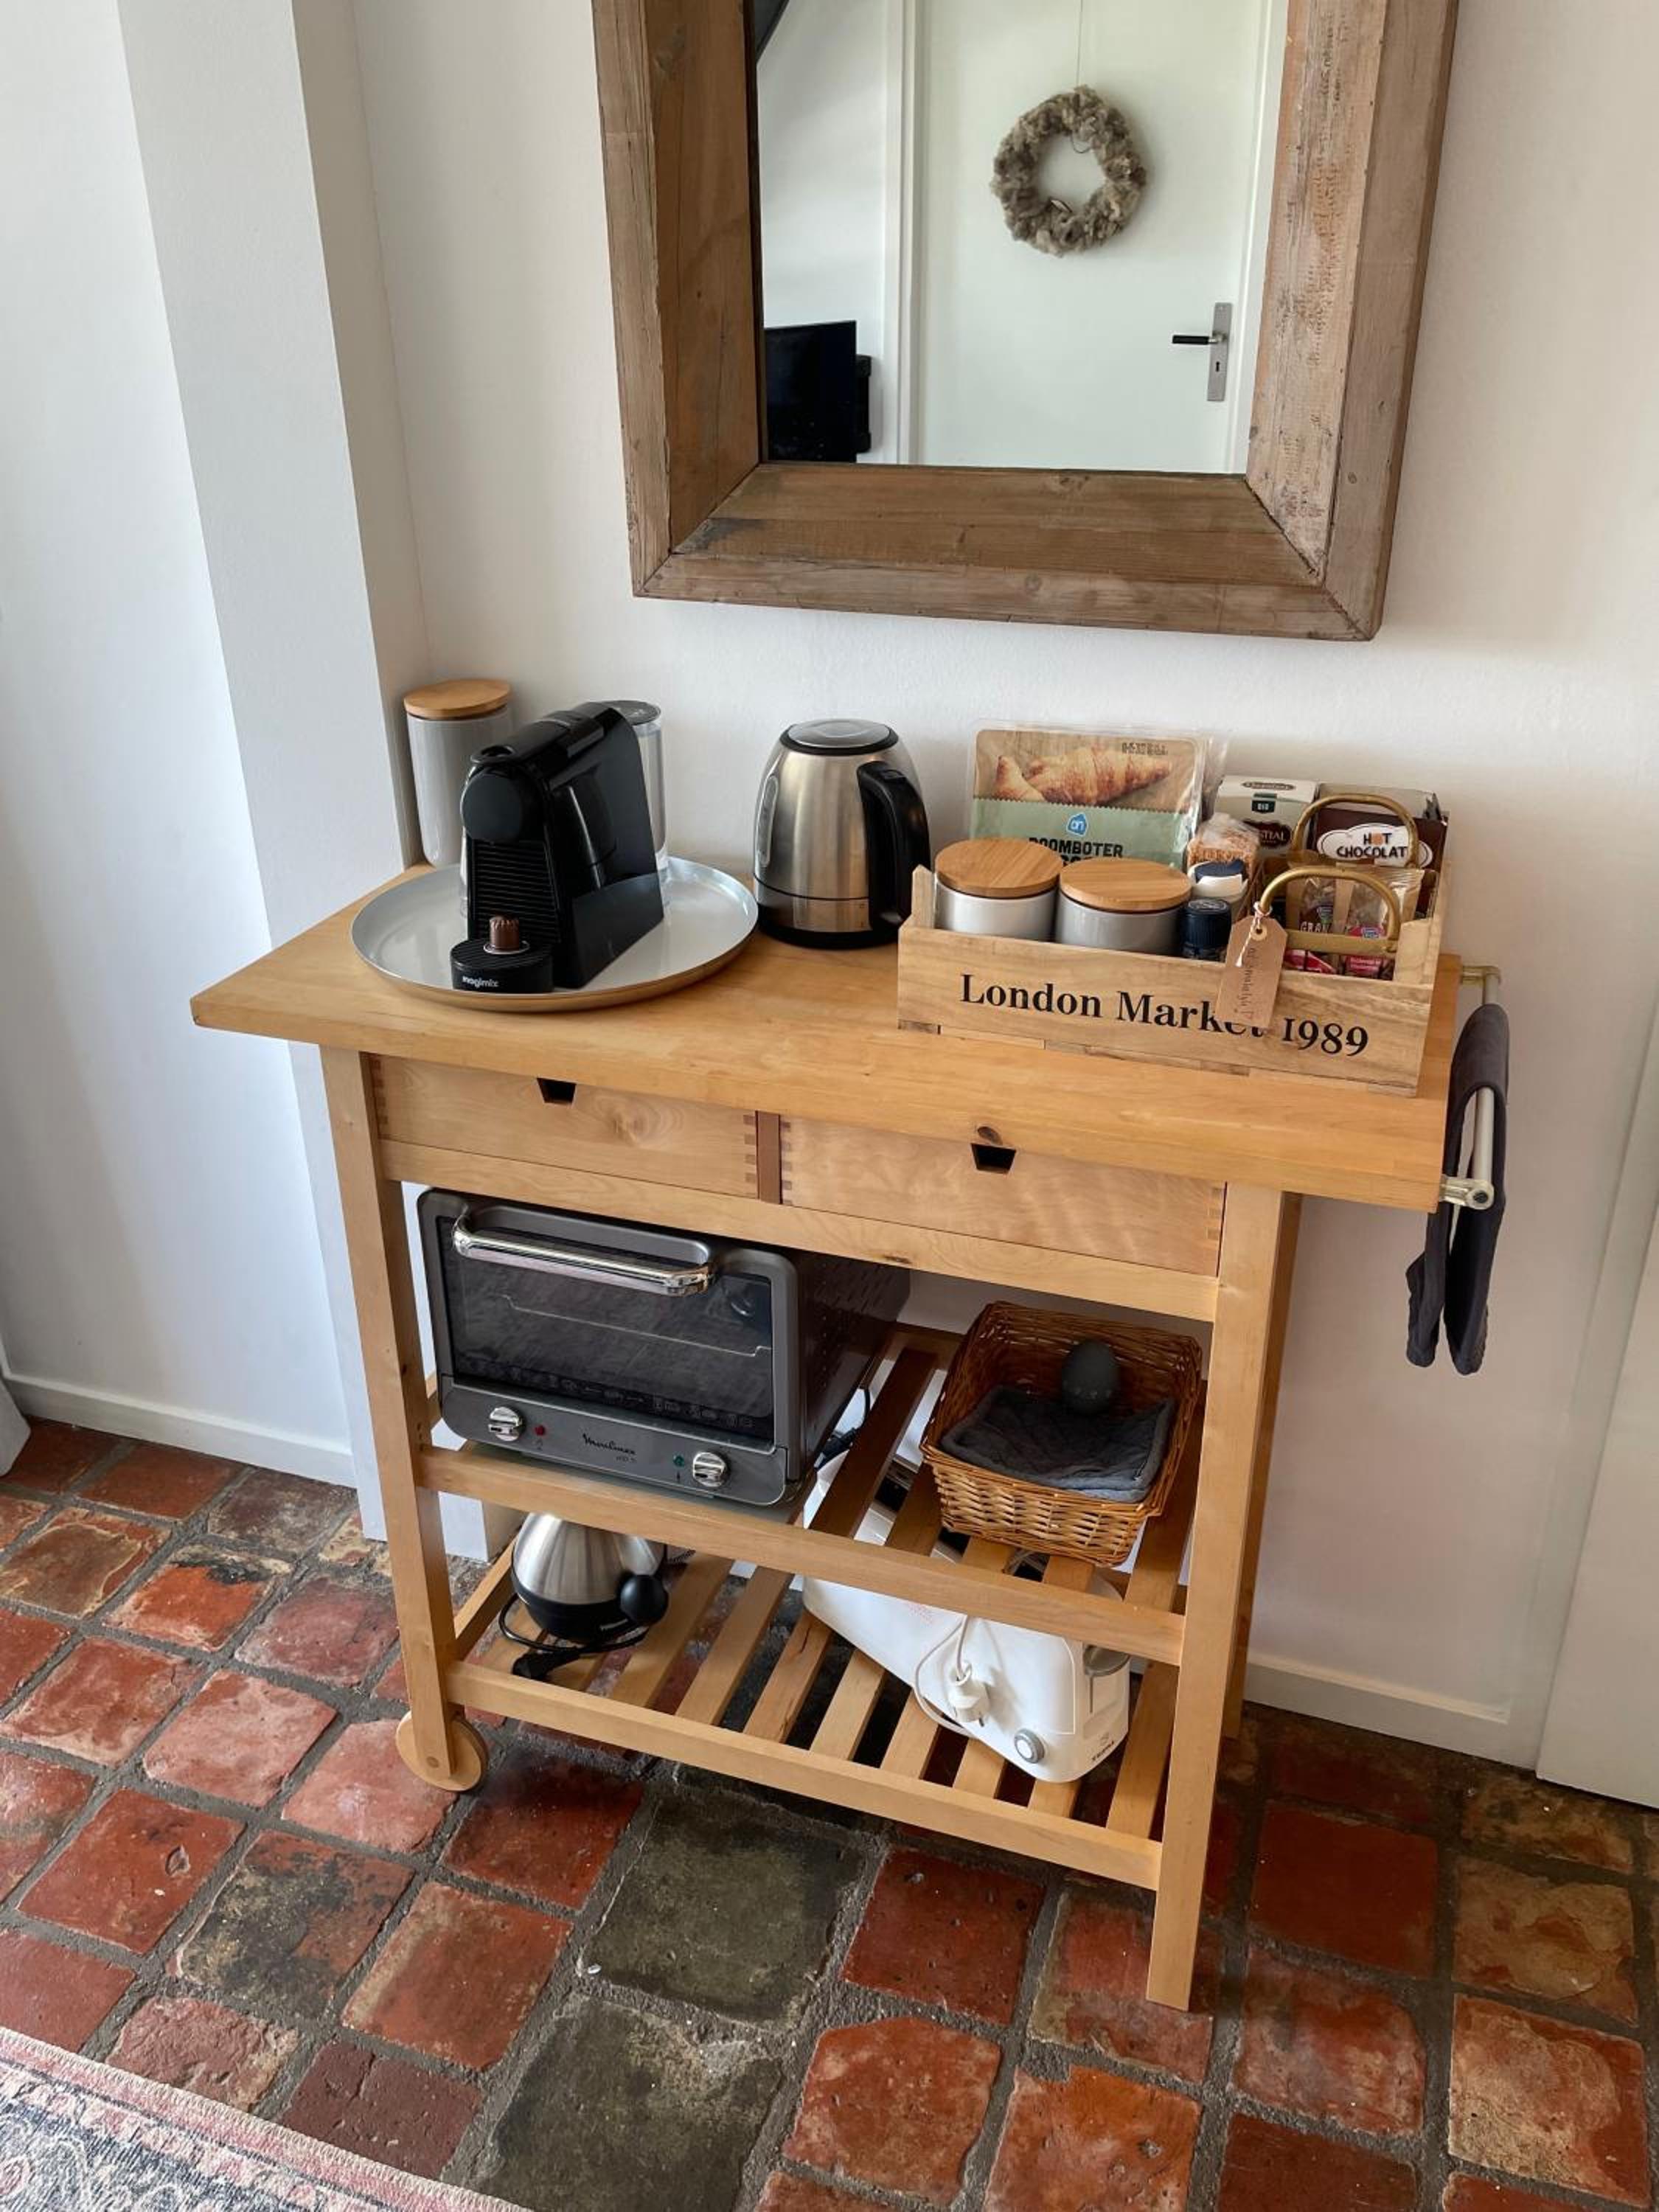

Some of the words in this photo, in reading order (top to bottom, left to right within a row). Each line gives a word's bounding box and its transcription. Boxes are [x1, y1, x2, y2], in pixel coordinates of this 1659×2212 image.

[1029, 837, 1124, 858] OOMBOTER
[1363, 832, 1393, 846] HOT
[1336, 846, 1408, 859] CHOCOLAT
[960, 974, 1103, 1018] London
[1281, 1017, 1369, 1057] 1989
